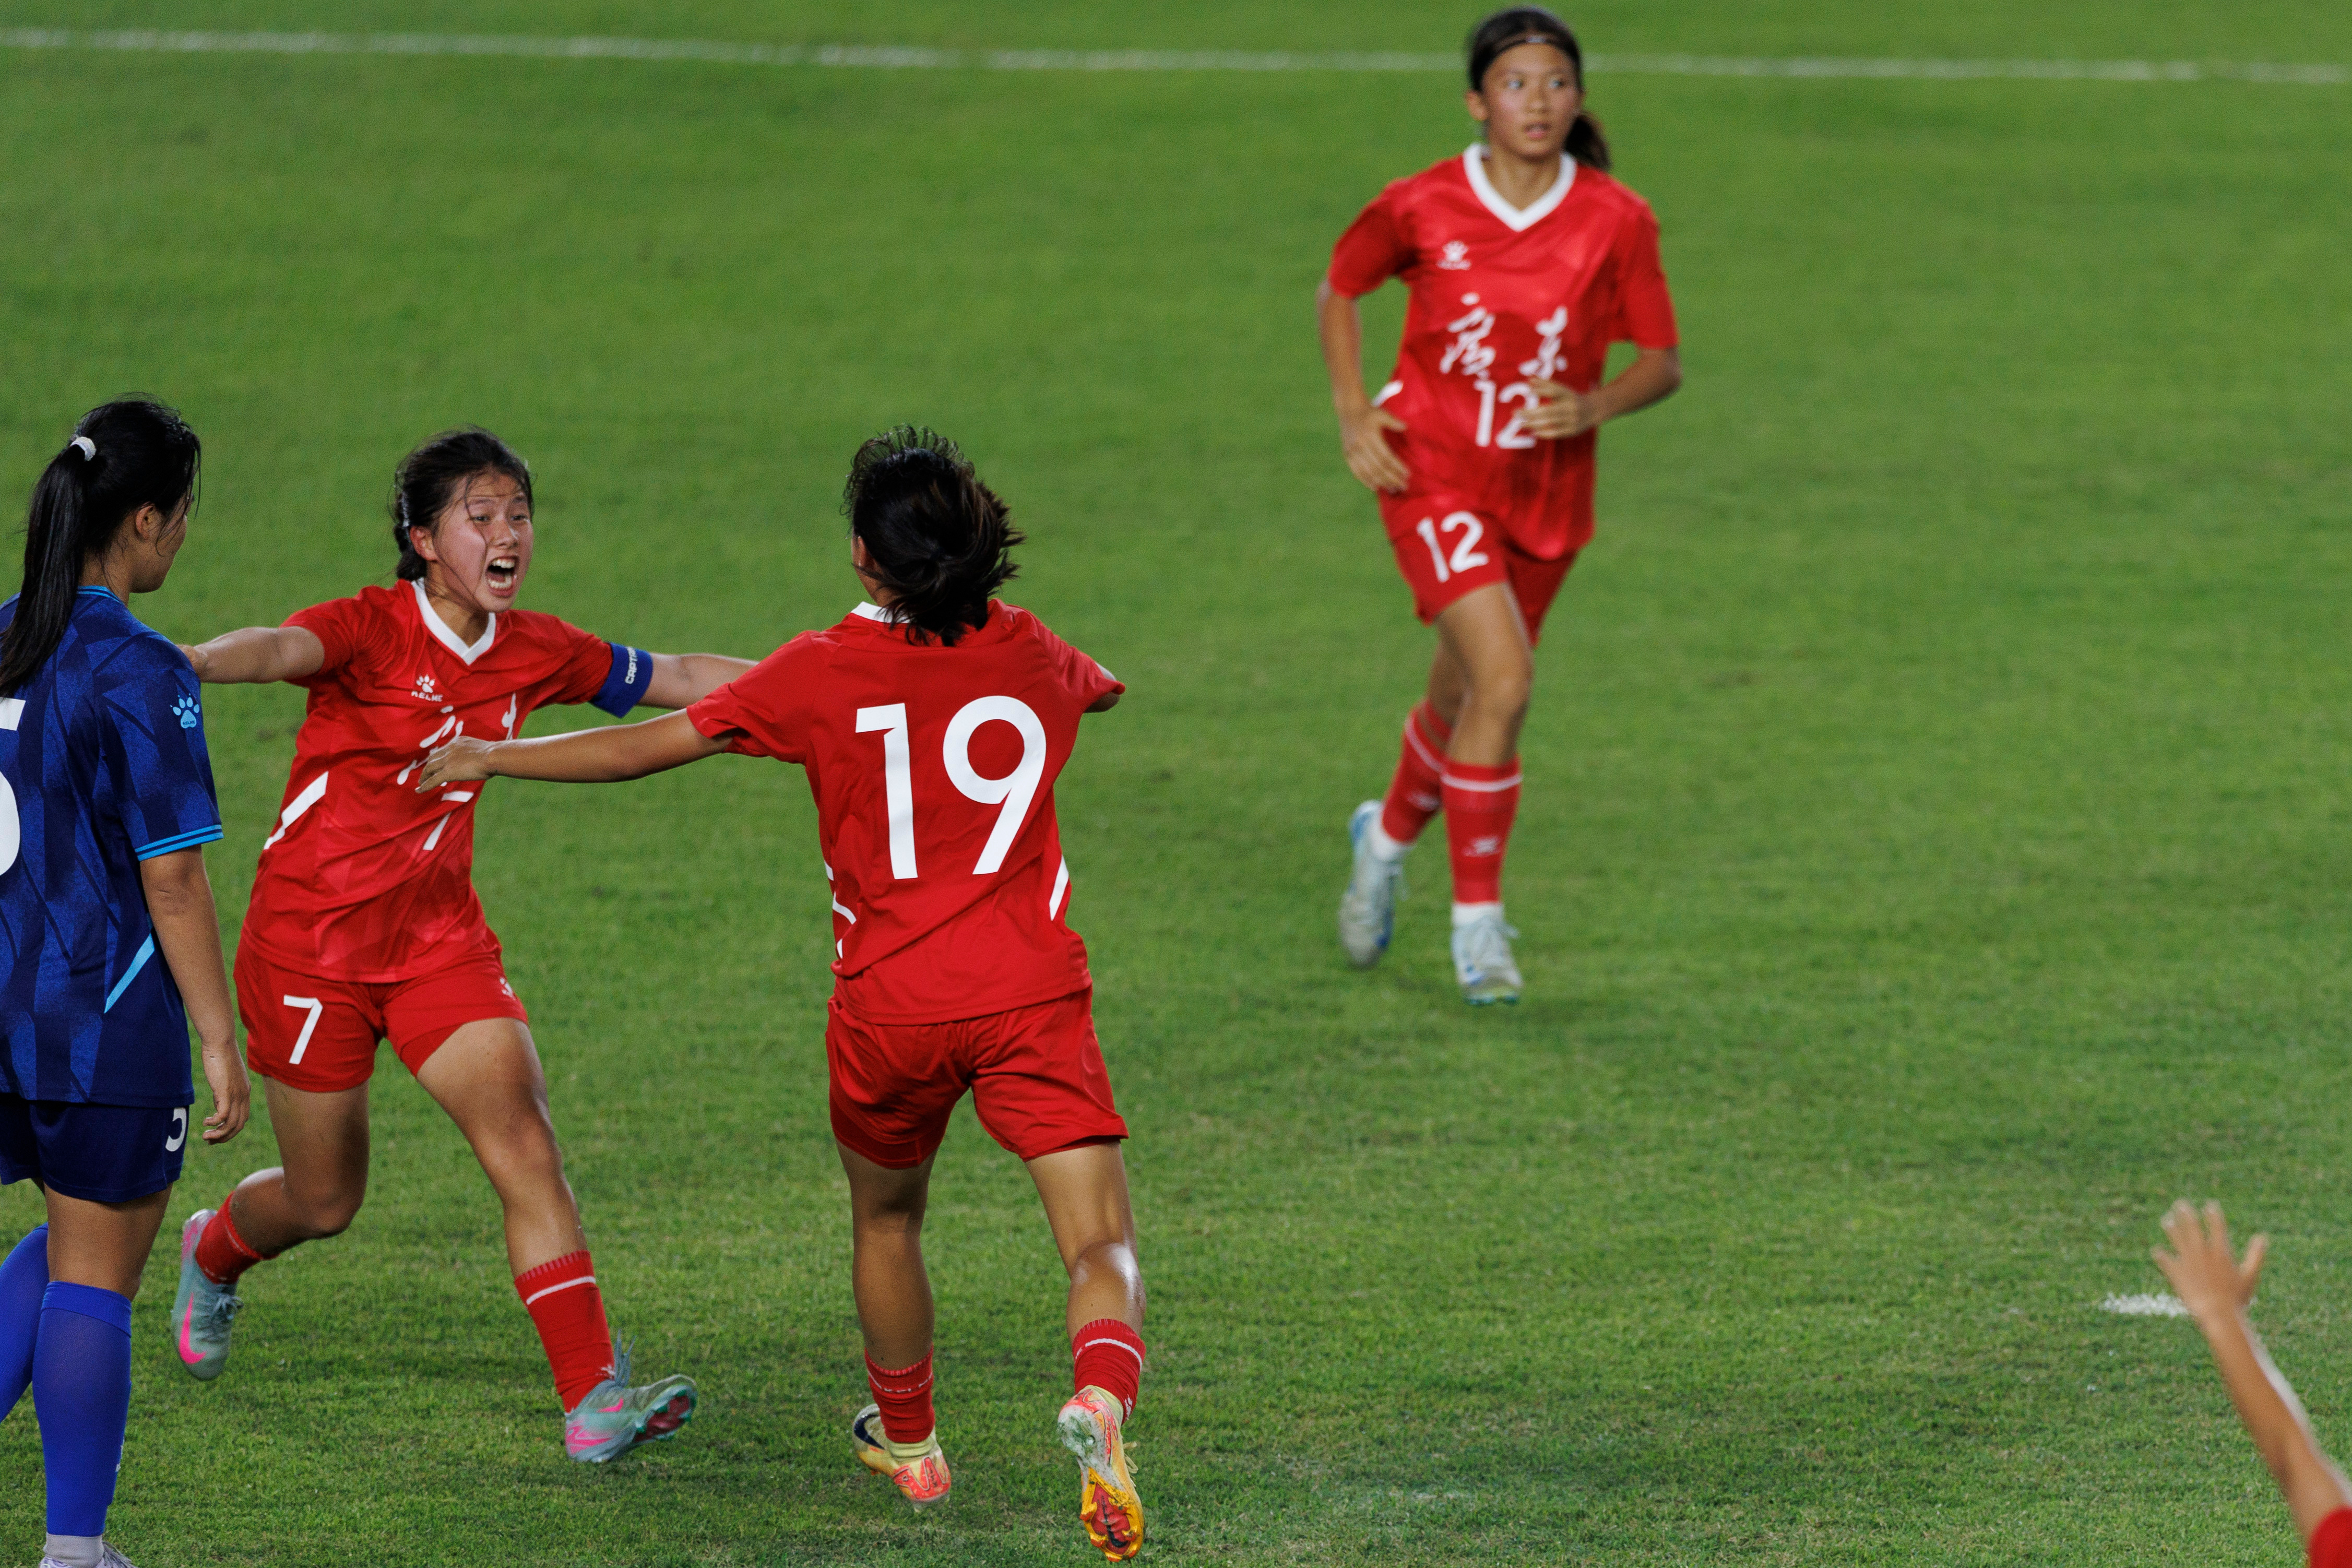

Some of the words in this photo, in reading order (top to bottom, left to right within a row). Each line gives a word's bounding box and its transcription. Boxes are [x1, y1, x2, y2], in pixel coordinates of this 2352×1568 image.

[1474, 379, 1539, 449] 12
[1417, 511, 1489, 583] 12
[856, 695, 1046, 880] 19
[283, 994, 323, 1065] 7
